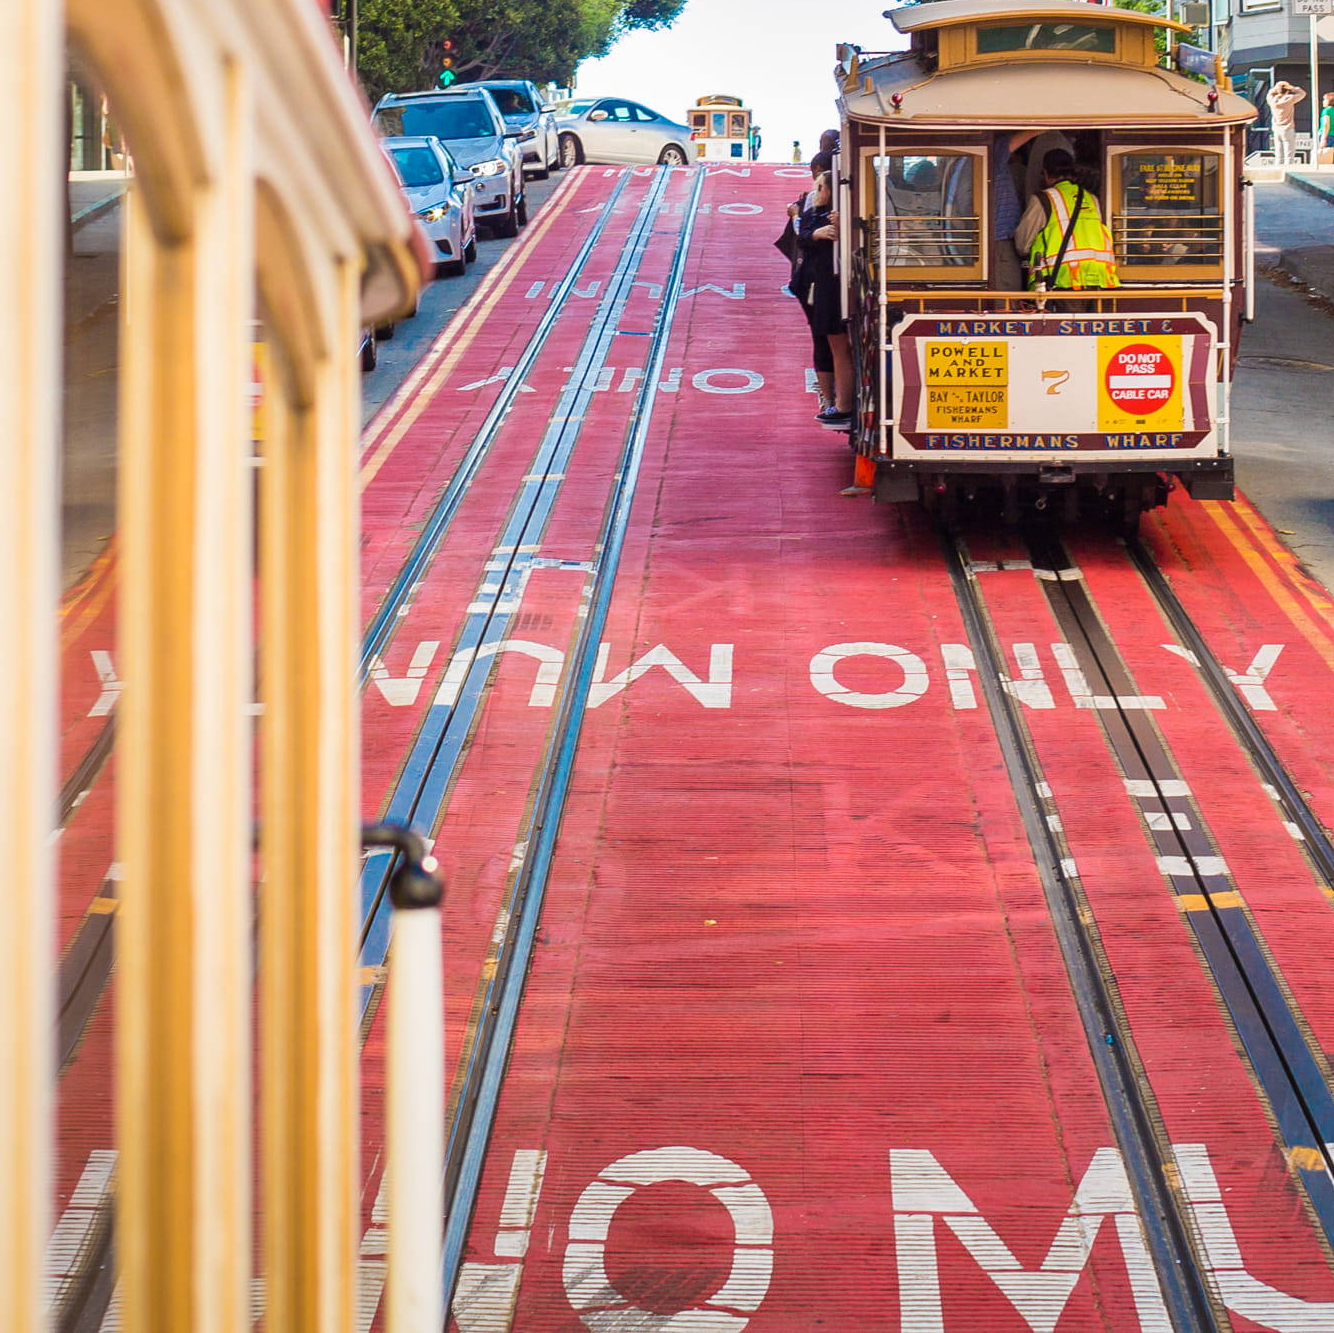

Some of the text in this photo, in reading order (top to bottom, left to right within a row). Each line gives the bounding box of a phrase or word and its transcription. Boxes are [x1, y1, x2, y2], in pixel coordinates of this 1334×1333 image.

[1302, 4, 1325, 12] PASS
[936, 321, 1033, 335] MARKET
[1058, 319, 1151, 335] STREET
[930, 347, 1004, 358] POWELL
[950, 359, 985, 367] AND
[1118, 353, 1163, 364] DO NOT
[929, 367, 1004, 378] MARKET
[1125, 364, 1156, 374] PASS
[1041, 369, 1070, 395] 7
[930, 390, 948, 403] BAY
[965, 391, 1004, 403] TAYLOR
[1112, 389, 1169, 400] CABLE CAR
[936, 406, 998, 415] FISHERMANS
[951, 415, 983, 424] WHARF
[926, 433, 1183, 450] FISHERMANS WHARF
[809, 642, 1285, 711] ONLY
